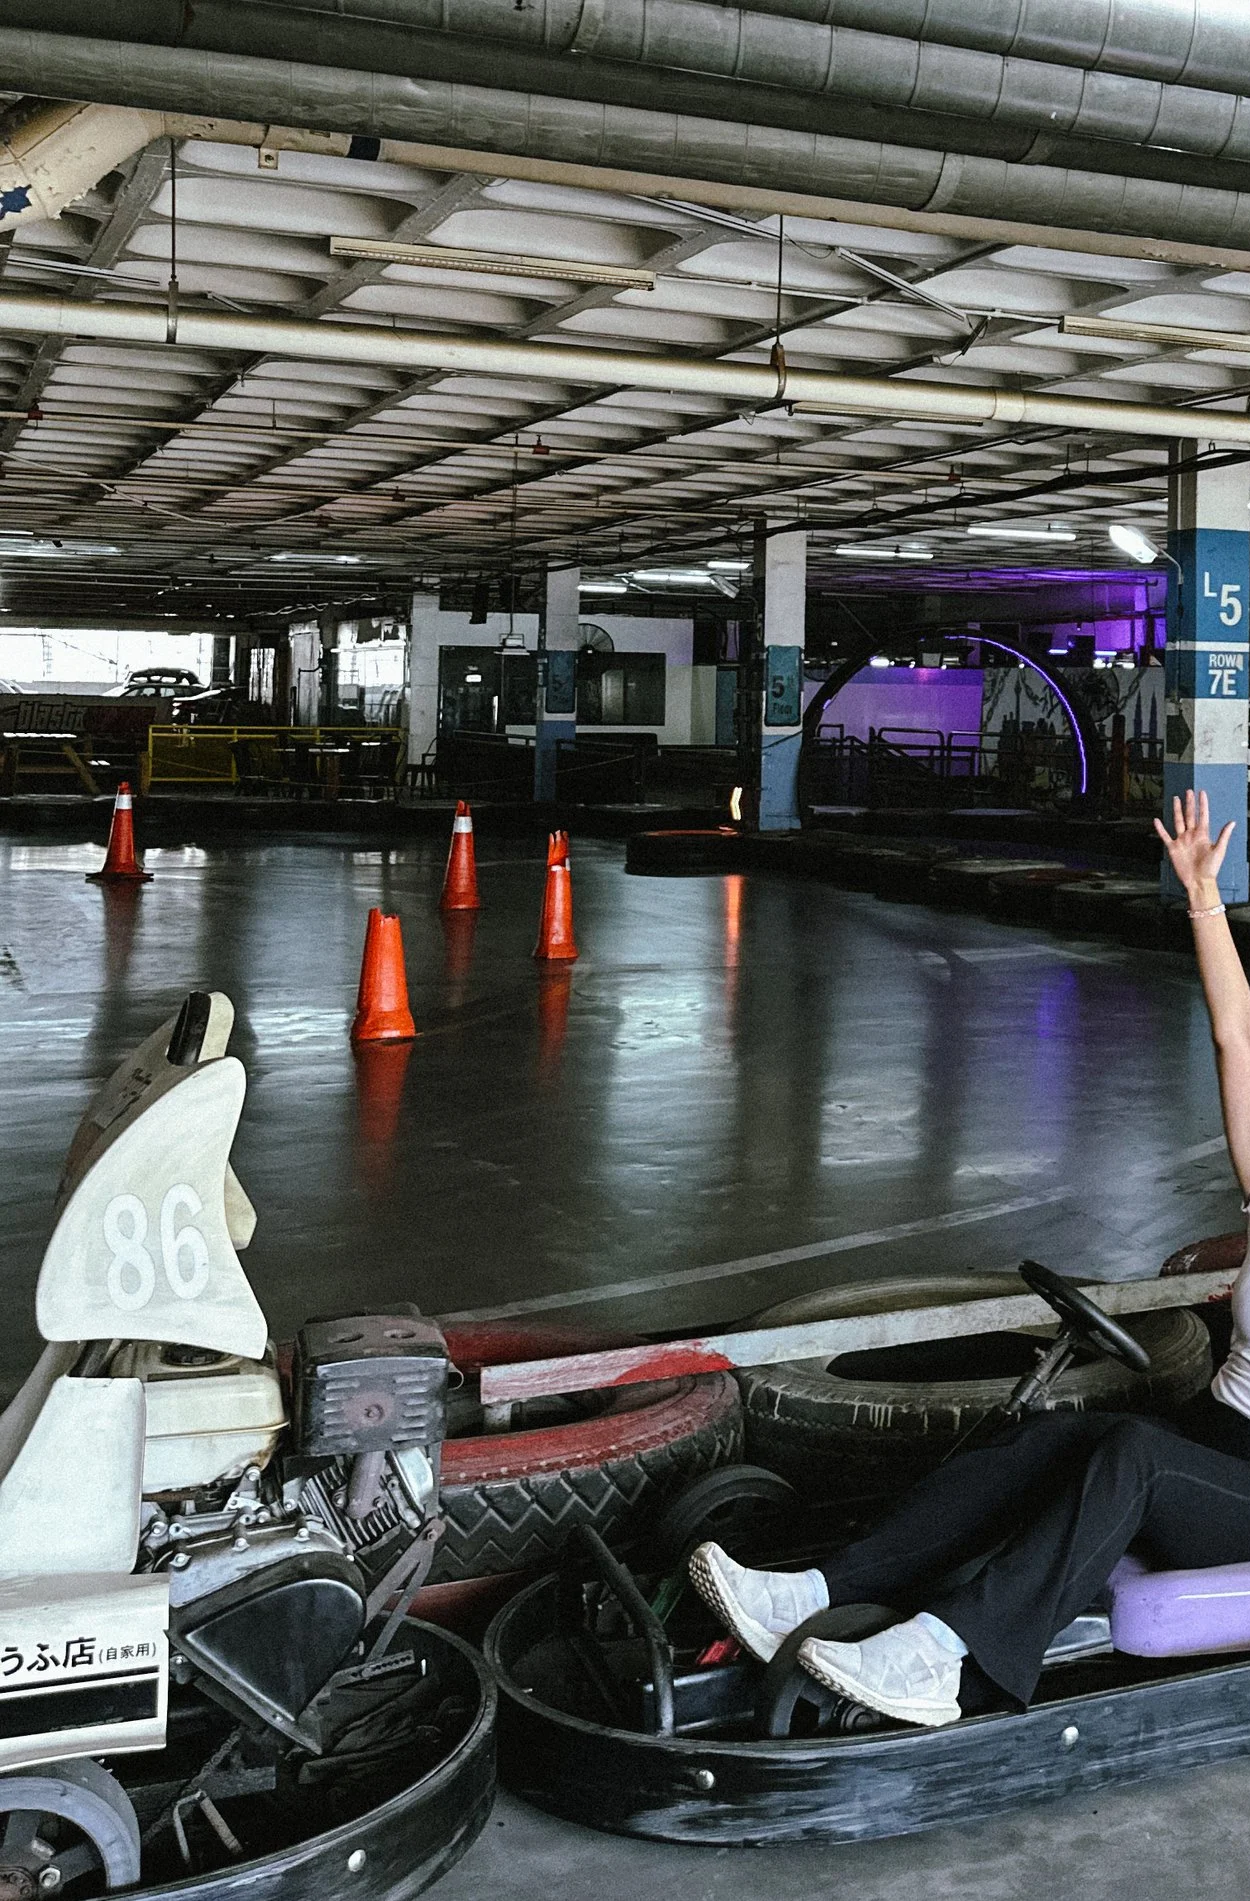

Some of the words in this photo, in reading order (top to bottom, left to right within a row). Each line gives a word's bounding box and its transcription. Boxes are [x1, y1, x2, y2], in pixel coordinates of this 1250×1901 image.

[1208, 653, 1237, 667] ROW
[1207, 669, 1237, 696] 7E
[103, 1181, 210, 1311] 86
